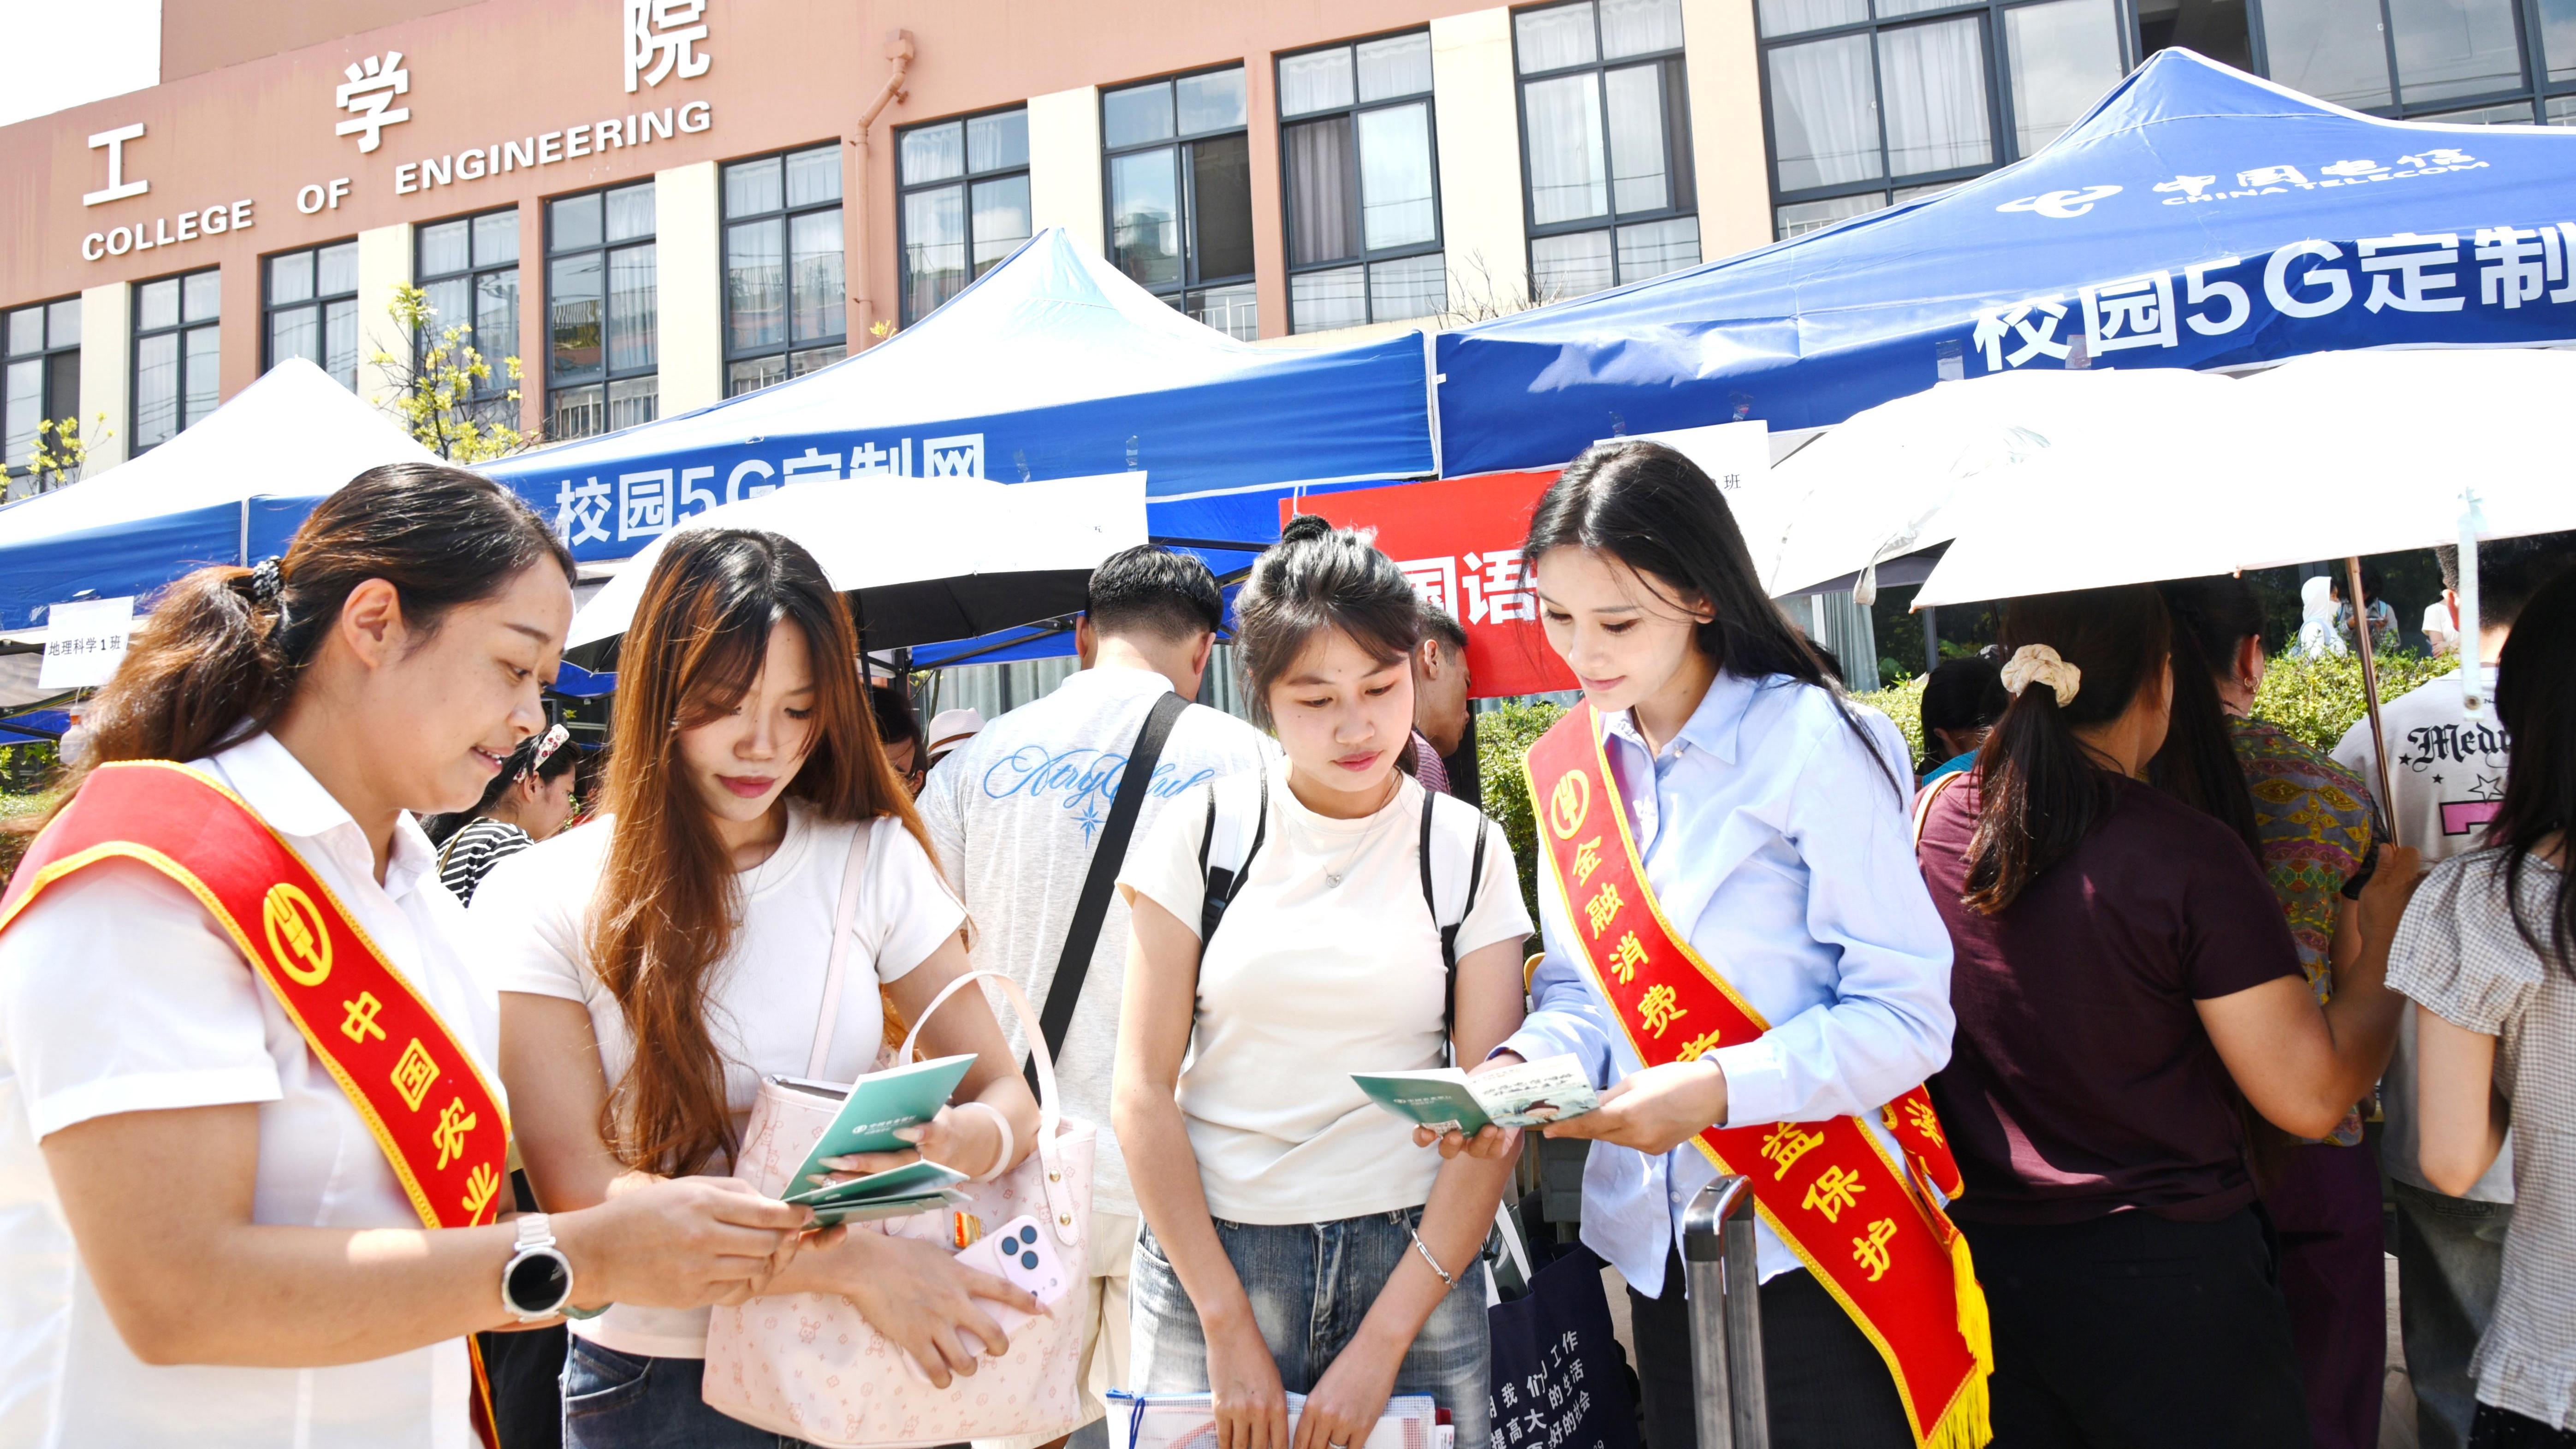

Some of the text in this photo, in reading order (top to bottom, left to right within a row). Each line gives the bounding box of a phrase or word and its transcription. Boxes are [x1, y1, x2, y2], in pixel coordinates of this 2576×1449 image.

[82, 101, 711, 261] COLLEGE OF ENGINEERING
[2162, 161, 2490, 205] CHINA TELECOM
[1971, 222, 2576, 372] 校园5G定制
